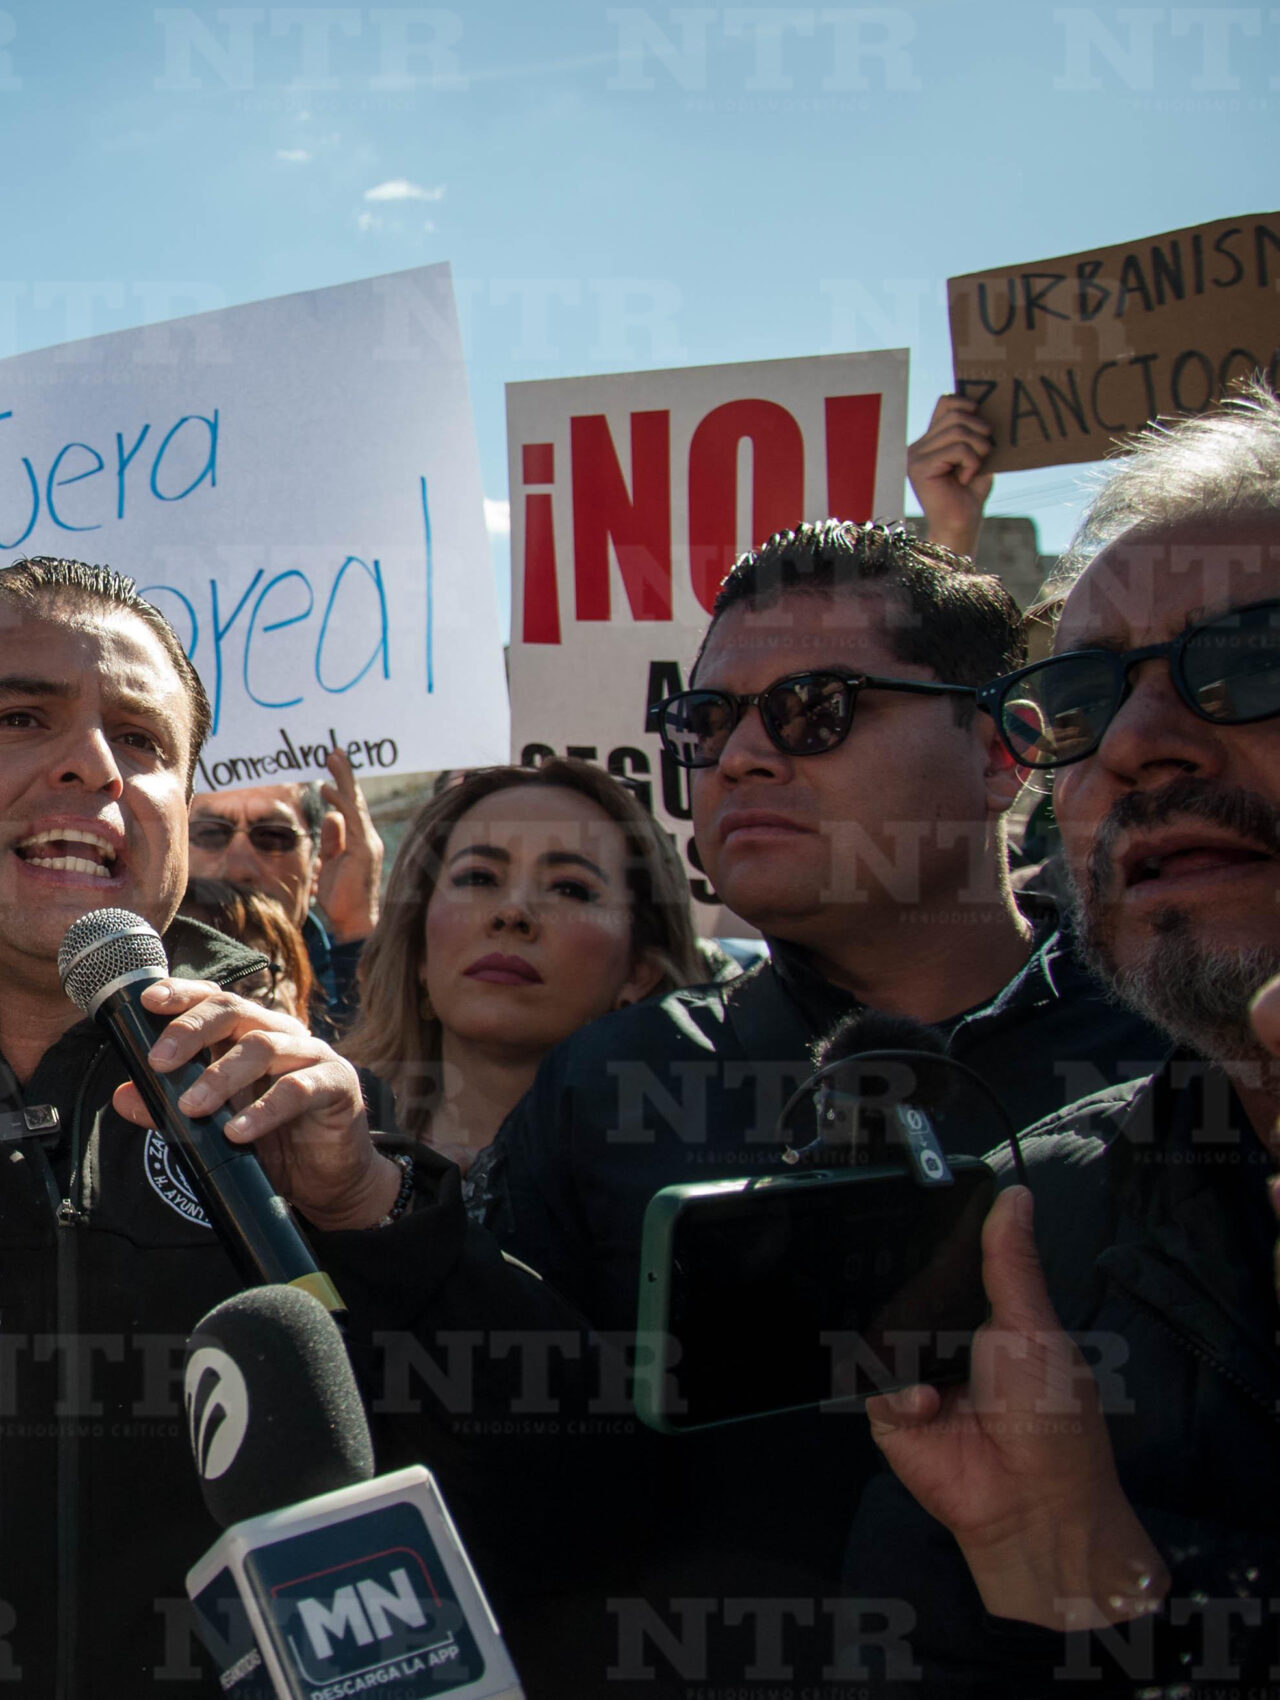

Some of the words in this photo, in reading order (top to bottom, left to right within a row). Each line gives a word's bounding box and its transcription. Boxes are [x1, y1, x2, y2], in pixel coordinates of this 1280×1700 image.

[297, 1567, 427, 1660] MN
[401, 1656, 425, 1677] LA
[428, 1645, 461, 1668] APP
